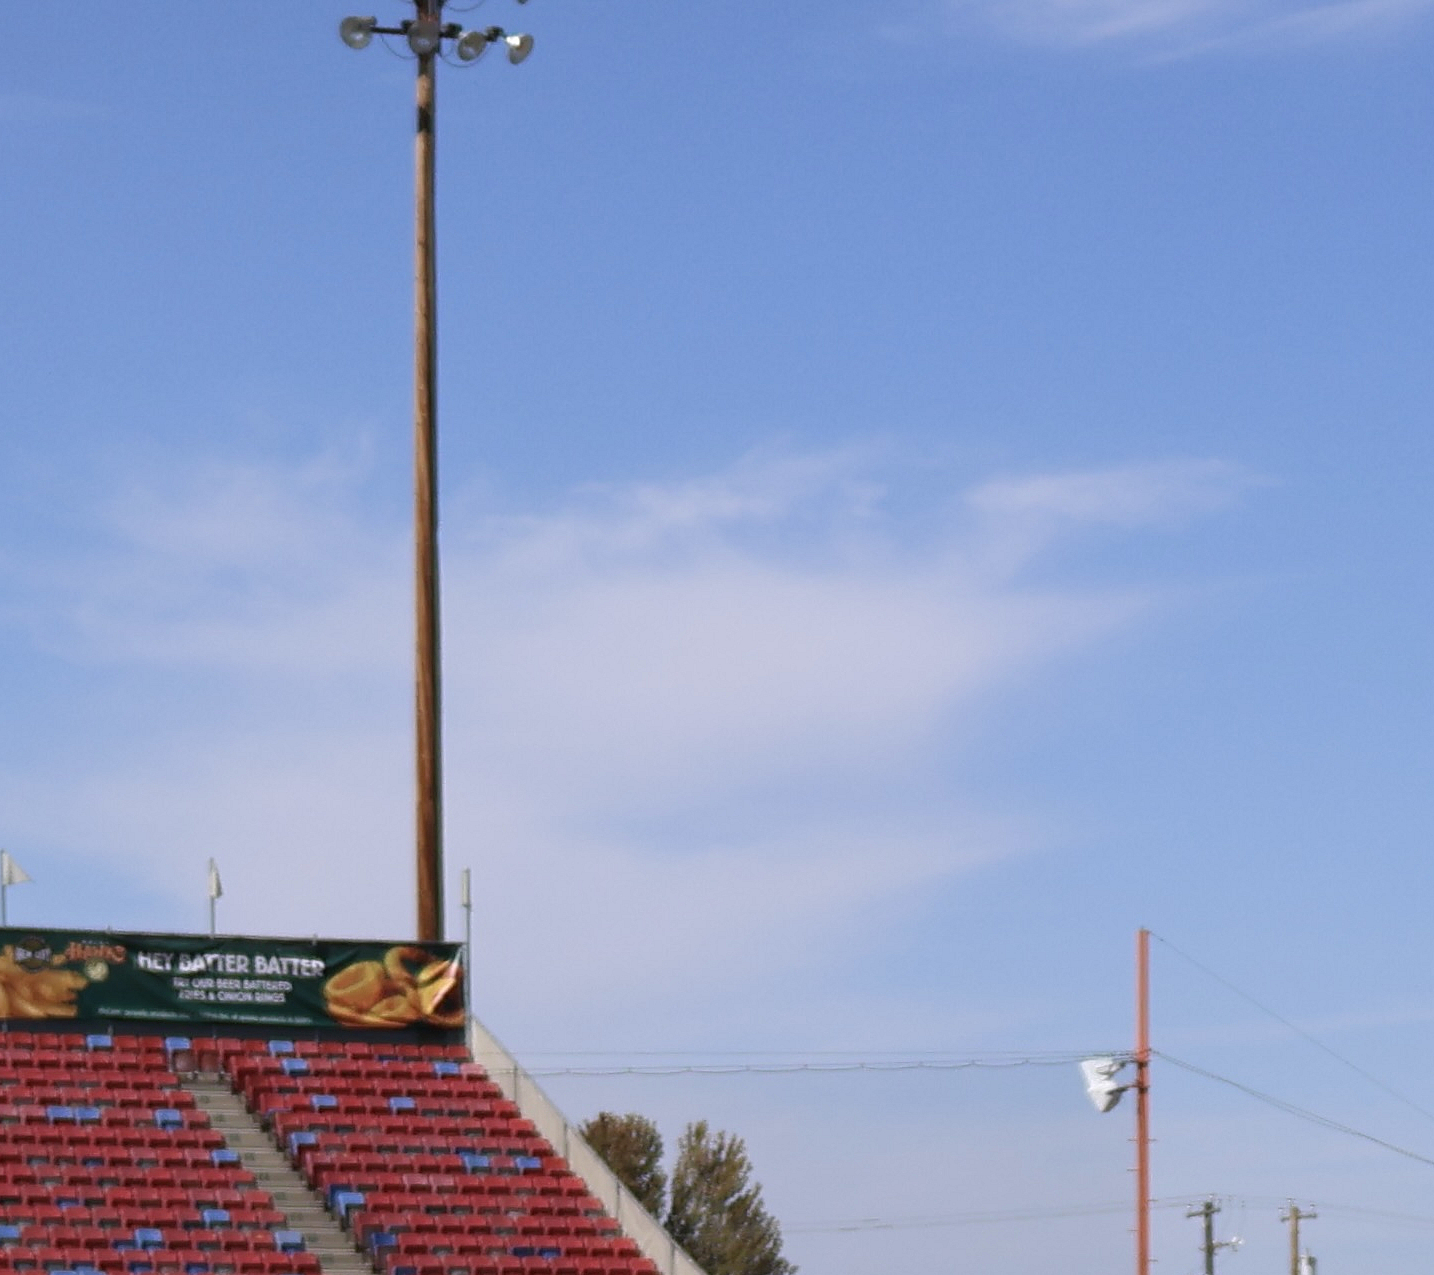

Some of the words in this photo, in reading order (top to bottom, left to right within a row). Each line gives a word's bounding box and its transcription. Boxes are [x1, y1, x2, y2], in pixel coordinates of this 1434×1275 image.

[136, 951, 175, 972] HEY
[177, 953, 249, 974] BATTER
[254, 956, 325, 978] BATTER
[216, 979, 241, 990] BEER
